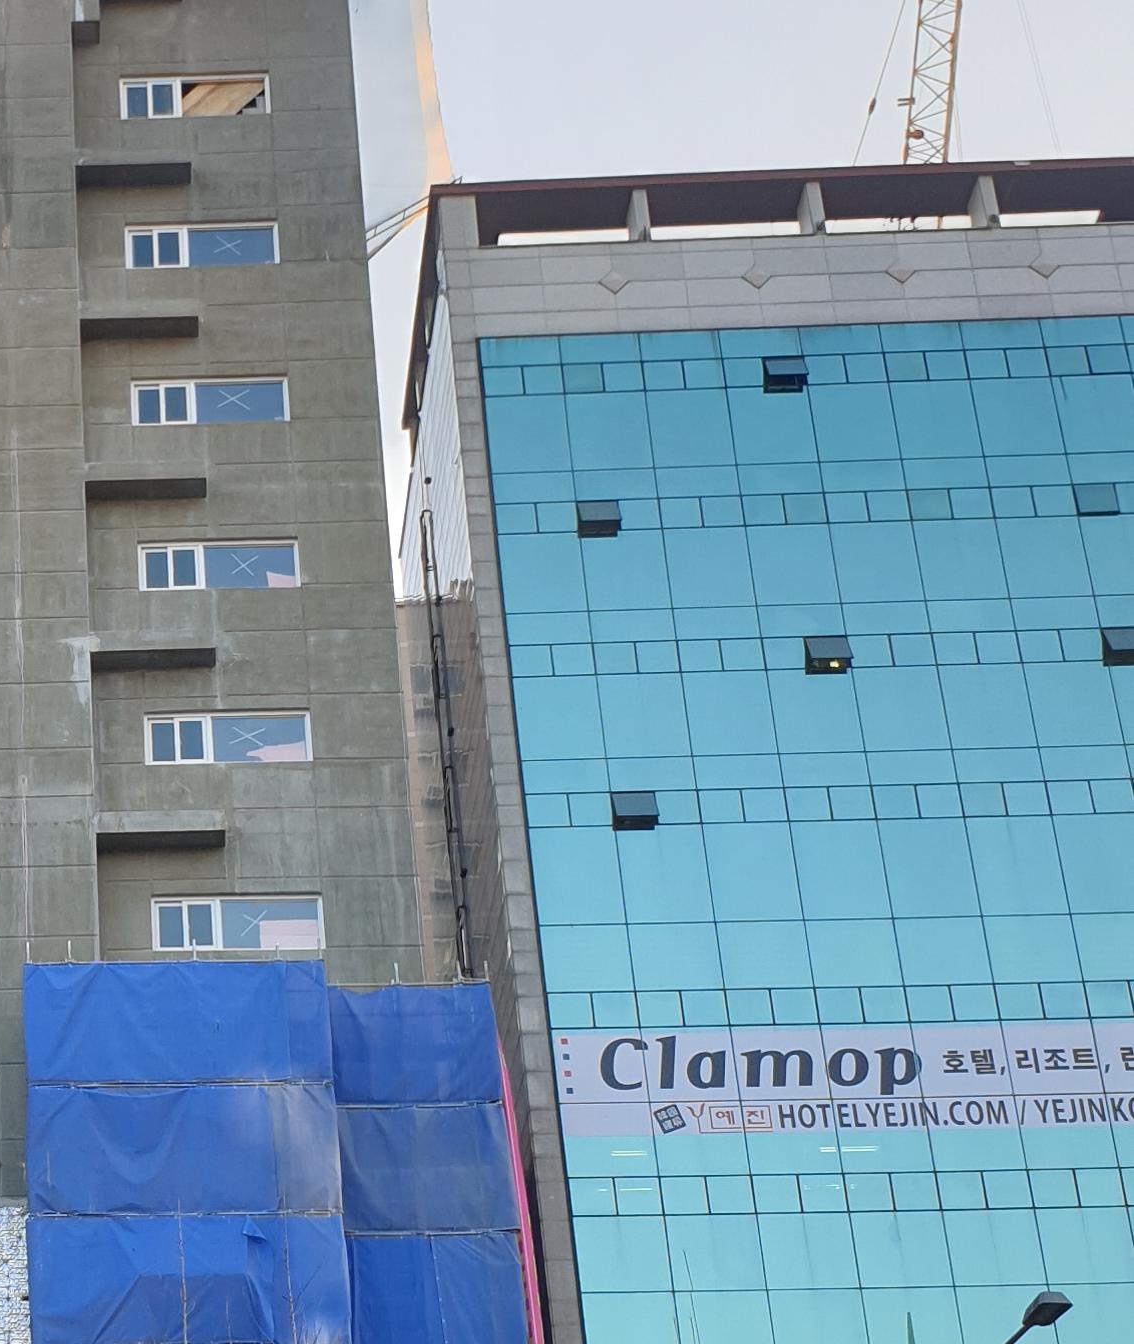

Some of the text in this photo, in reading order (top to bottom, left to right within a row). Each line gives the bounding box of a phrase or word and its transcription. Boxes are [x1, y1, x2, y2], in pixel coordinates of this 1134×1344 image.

[599, 1035, 922, 1096] Clamop
[943, 1048, 1006, 1075] 호텔,
[1015, 1047, 1110, 1074] 리조트,
[777, 1100, 1009, 1129] HOTELYEJIN.COM
